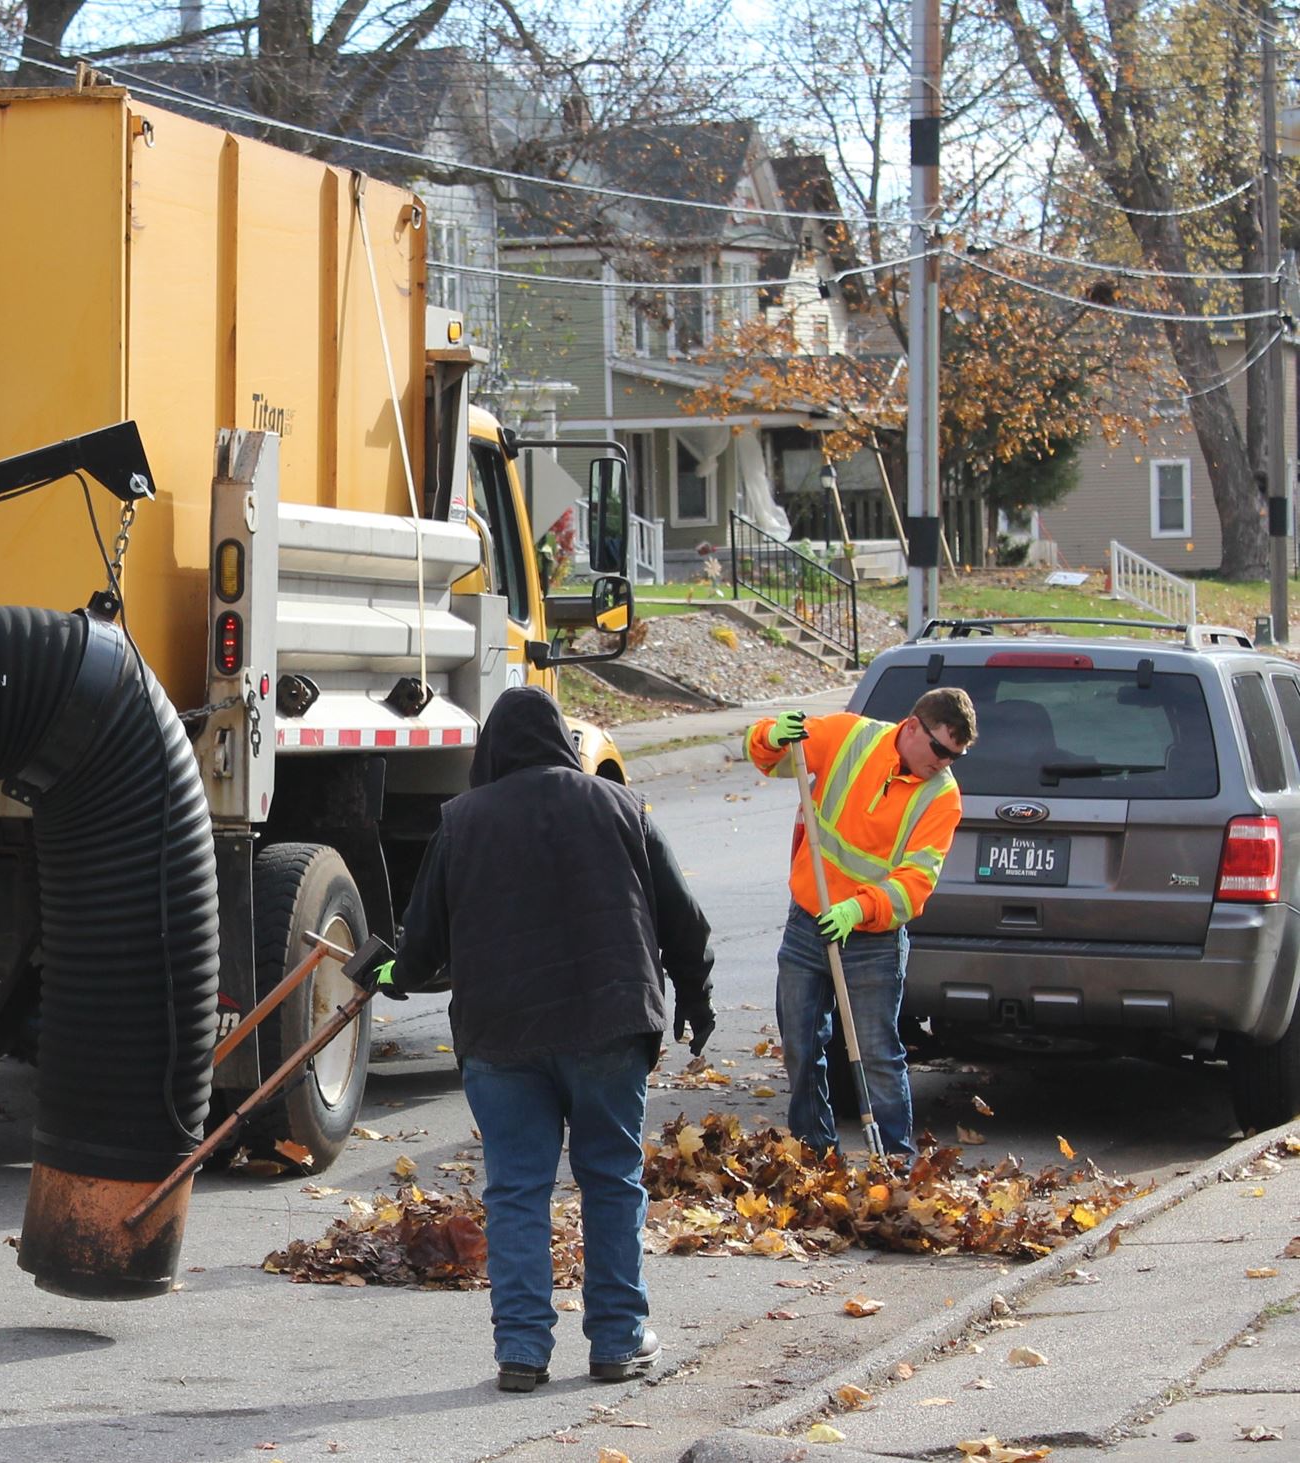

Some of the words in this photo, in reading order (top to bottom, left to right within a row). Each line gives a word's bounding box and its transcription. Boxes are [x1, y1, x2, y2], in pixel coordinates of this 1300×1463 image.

[252, 393, 284, 438] Titan
[1009, 806, 1033, 817] Ford
[1012, 838, 1036, 848] IOWA
[989, 847, 1020, 869] PAE
[1025, 849, 1055, 870] 015
[1005, 869, 1038, 877] MUSCATINE
